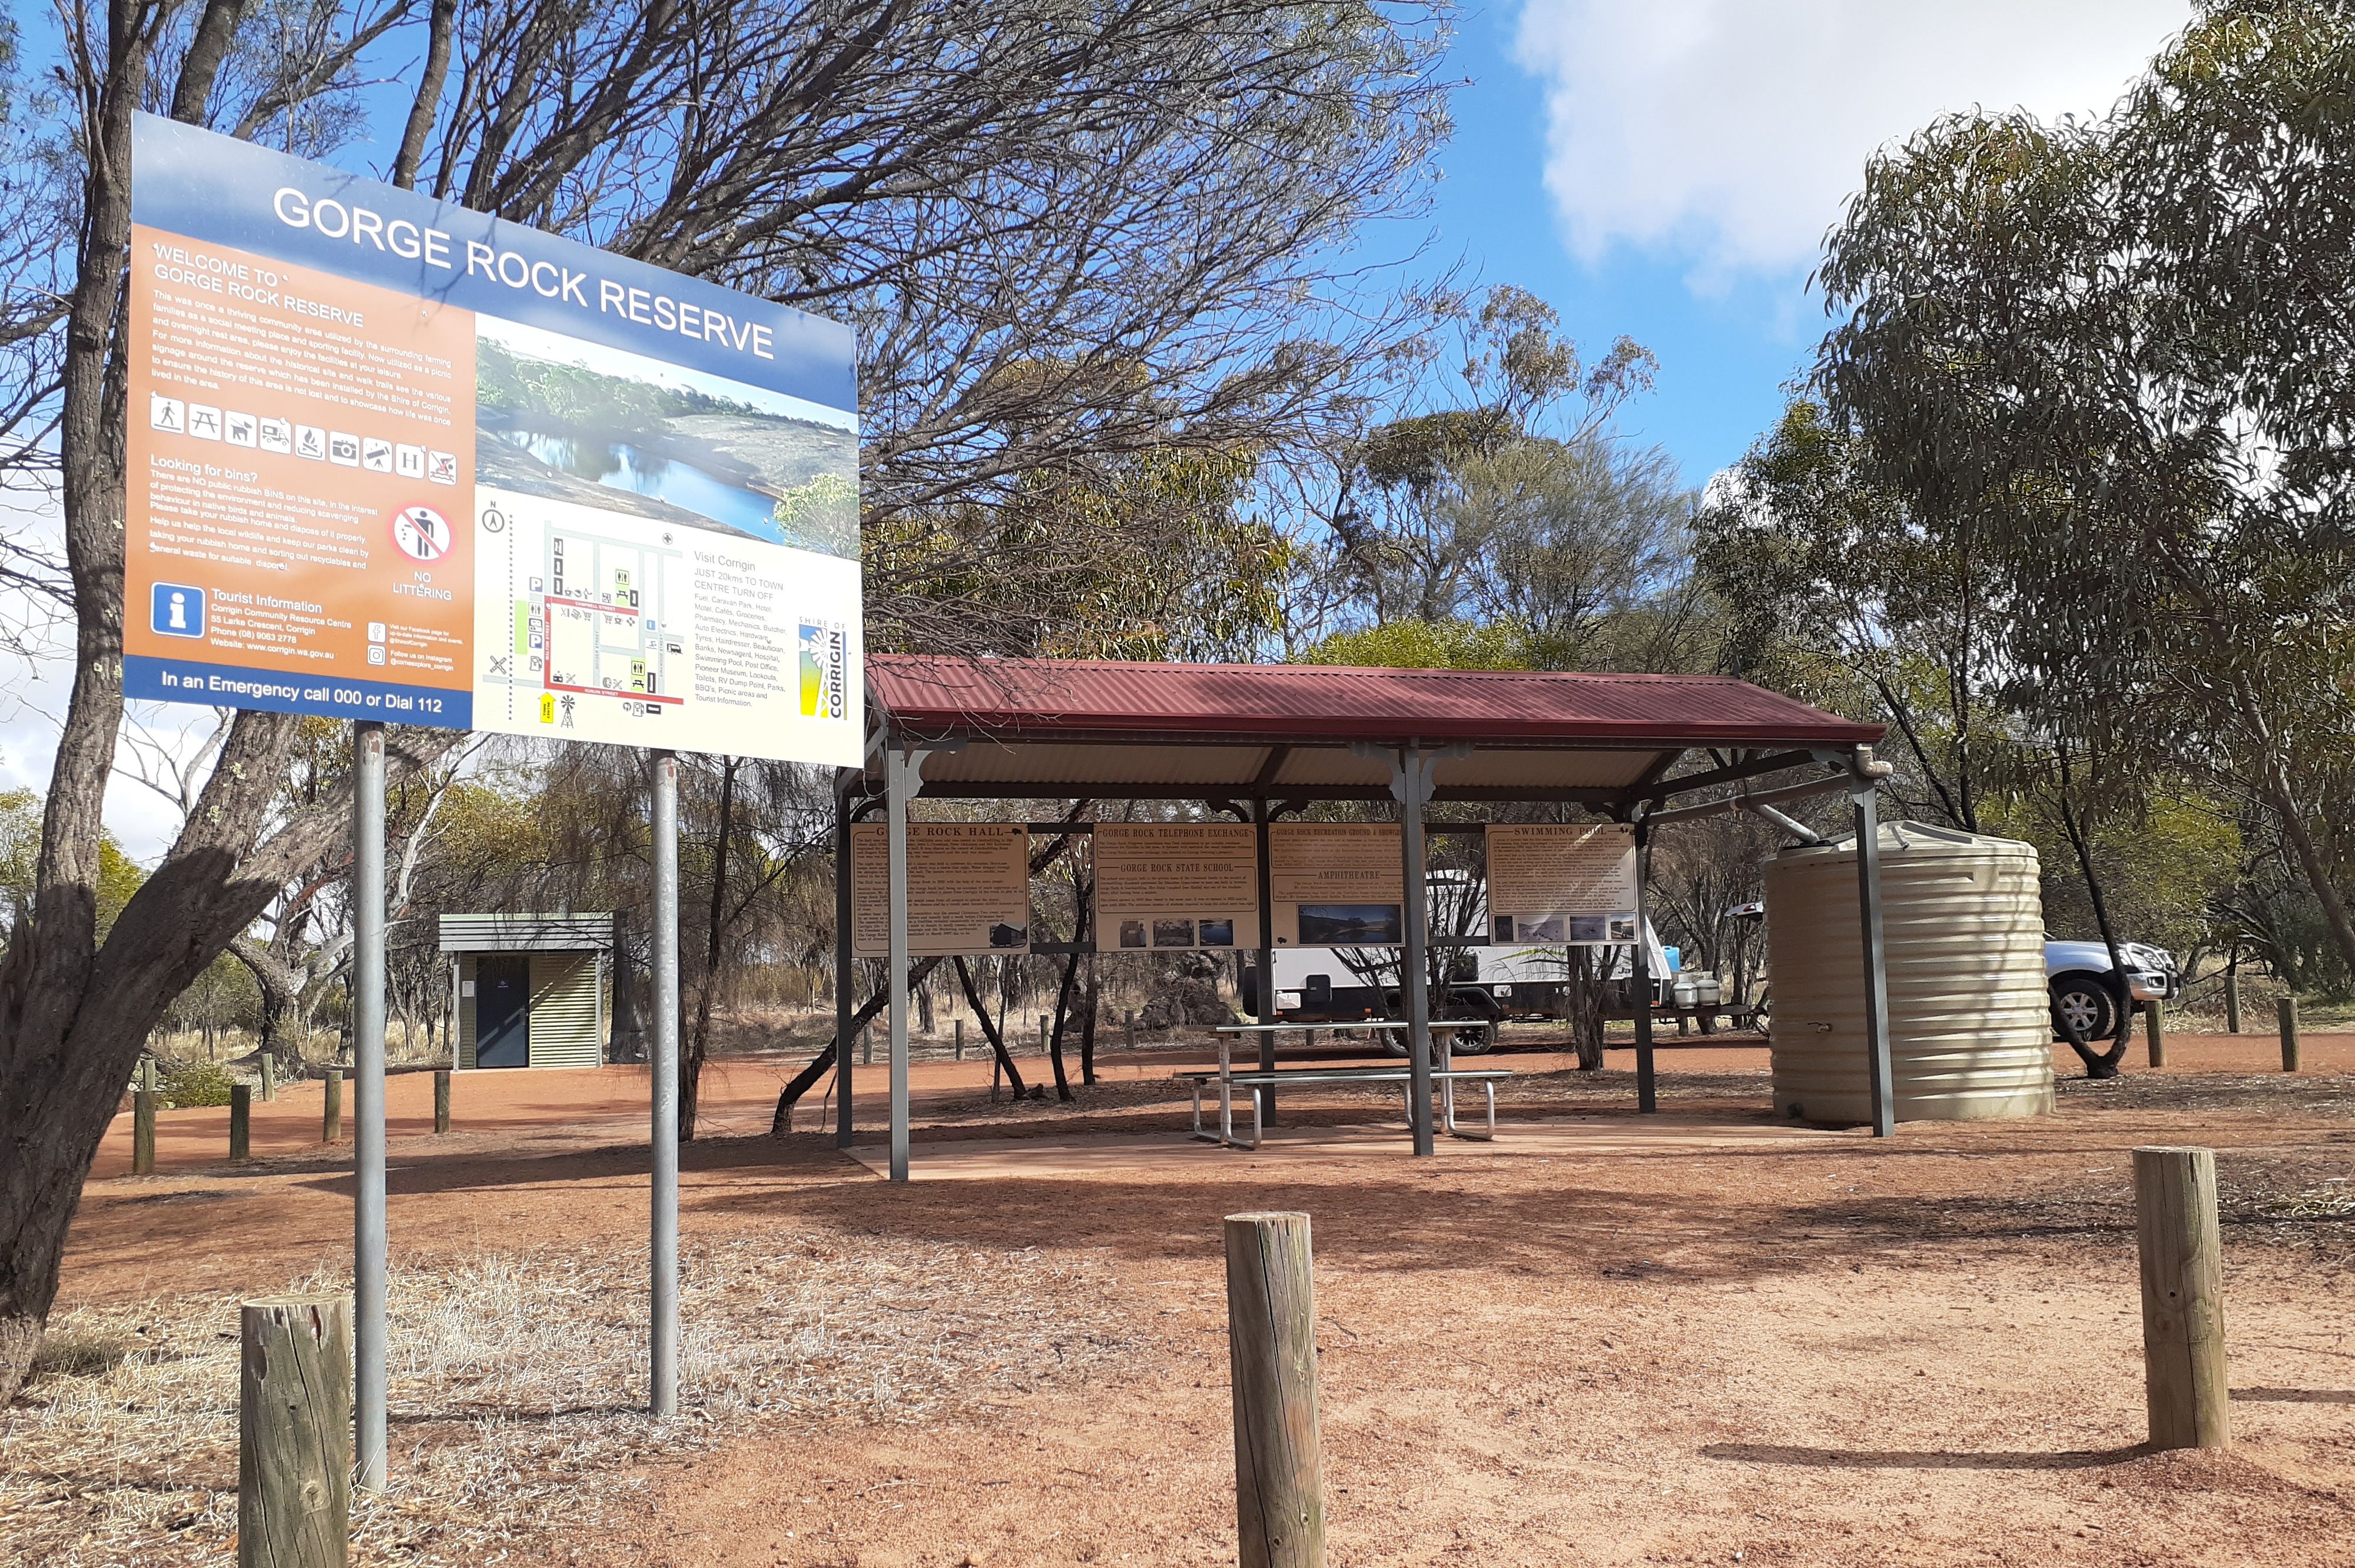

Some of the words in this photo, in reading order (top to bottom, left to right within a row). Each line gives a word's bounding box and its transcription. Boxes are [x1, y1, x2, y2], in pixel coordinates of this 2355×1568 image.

[157, 245, 248, 280] WELCOME
[253, 268, 277, 287] TO
[273, 187, 452, 269] GORGE
[466, 240, 588, 308] ROCK
[601, 281, 774, 360] RESERVE
[154, 264, 222, 293] GORGE
[228, 281, 279, 307] ROCK
[284, 295, 363, 327] RESERVE
[154, 289, 171, 301] This
[174, 296, 192, 305] was
[194, 301, 215, 311] once
[227, 307, 256, 323] thriving
[259, 316, 301, 333] community
[304, 327, 322, 337] area
[324, 332, 351, 343] utilized
[366, 340, 377, 350] the
[380, 345, 422, 361] surrounding
[425, 354, 451, 368] farming
[150, 454, 201, 476] Looking
[204, 463, 222, 476] for
[225, 467, 257, 482] bins?
[150, 469, 175, 480] There
[176, 475, 190, 483] are
[192, 474, 206, 486] NO
[208, 480, 231, 490] public
[233, 485, 262, 495] rubbish
[264, 489, 284, 499] BINS
[297, 495, 311, 504] this
[160, 483, 200, 497] protecting
[202, 489, 215, 499] the
[217, 493, 265, 507] environment
[267, 501, 281, 510] and
[283, 504, 316, 517] reducing
[694, 550, 715, 563] Visit
[718, 555, 755, 572] Corrigin
[414, 570, 432, 583] NO
[694, 567, 715, 577] JUST
[718, 572, 742, 583] 20kms
[745, 576, 756, 586] TO
[759, 579, 783, 590] TOWN
[393, 582, 452, 600] LITTERING
[694, 580, 729, 593] CENTRE
[732, 586, 755, 597] TURN
[757, 591, 774, 601] OFF
[211, 588, 253, 604] Tourist
[256, 594, 322, 613] Information
[711, 596, 737, 606] Caravan
[211, 603, 242, 615] Corrigin
[244, 607, 287, 622] Community
[289, 613, 325, 625] Resource
[326, 618, 351, 629] Centre
[799, 616, 828, 627] SHIRE
[210, 626, 237, 636] Phone
[238, 629, 254, 639] (08)
[256, 631, 276, 640] 9063
[277, 634, 296, 643] 2778
[286, 624, 315, 636] Corrigin
[210, 637, 244, 648] Website:
[246, 643, 334, 659] www.corrigin.wa.gov.au
[695, 643, 716, 653] Banks,
[753, 642, 785, 653] Beautician,
[695, 653, 727, 665] Swimming
[728, 658, 743, 667] Pool,
[745, 660, 758, 669] Post
[695, 663, 719, 673] Pioneer
[749, 671, 777, 682] Lookouts,
[830, 631, 841, 719] CORRIGIN
[162, 670, 177, 686] In
[182, 676, 203, 689] an
[209, 676, 299, 701] Emergency
[304, 687, 329, 701] call
[334, 689, 361, 705] 000
[366, 695, 381, 706] or
[386, 693, 412, 709] Dial
[418, 697, 442, 712] 112
[695, 673, 716, 683] Toilets,
[729, 678, 747, 687] Dump
[767, 683, 785, 692] Parks,
[718, 686, 736, 695] Picnic
[695, 693, 715, 702] Tourist
[927, 827, 961, 836] ROCK
[969, 827, 1003, 836] HALL
[1102, 828, 1129, 837] GORGE
[1133, 828, 1153, 837] ROCK
[1158, 828, 1203, 837] TELEPHONE
[1208, 828, 1248, 837] EXCHANGE
[1578, 827, 1607, 835] POOL
[1120, 863, 1147, 872] GORGE
[1150, 863, 1172, 872] ROCK
[1176, 863, 1199, 872] STATE
[1203, 863, 1233, 872] SCHOOL
[1318, 871, 1381, 879] AMPHITHEATRE
